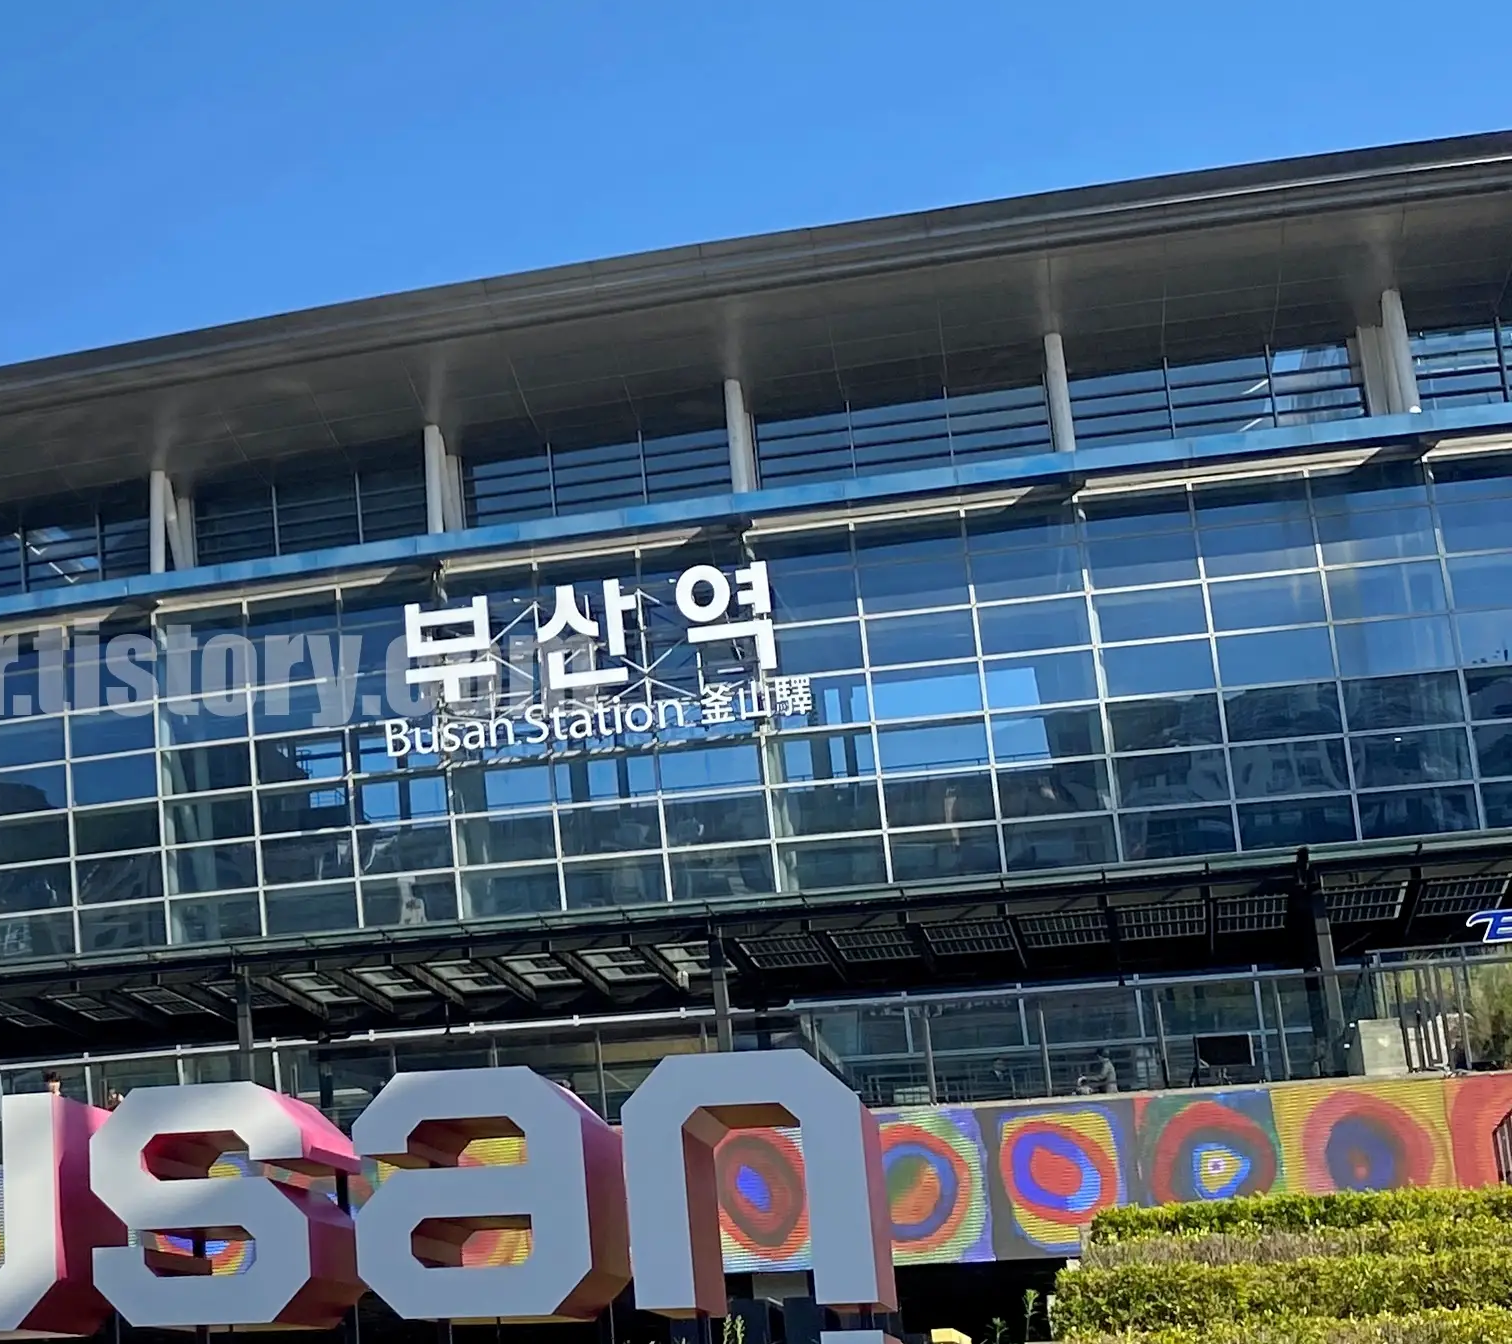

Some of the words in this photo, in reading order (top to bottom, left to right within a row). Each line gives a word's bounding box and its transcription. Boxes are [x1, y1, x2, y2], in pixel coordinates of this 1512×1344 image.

[403, 560, 778, 702] 부산역
[384, 716, 515, 758] Busan
[524, 696, 685, 745] Station
